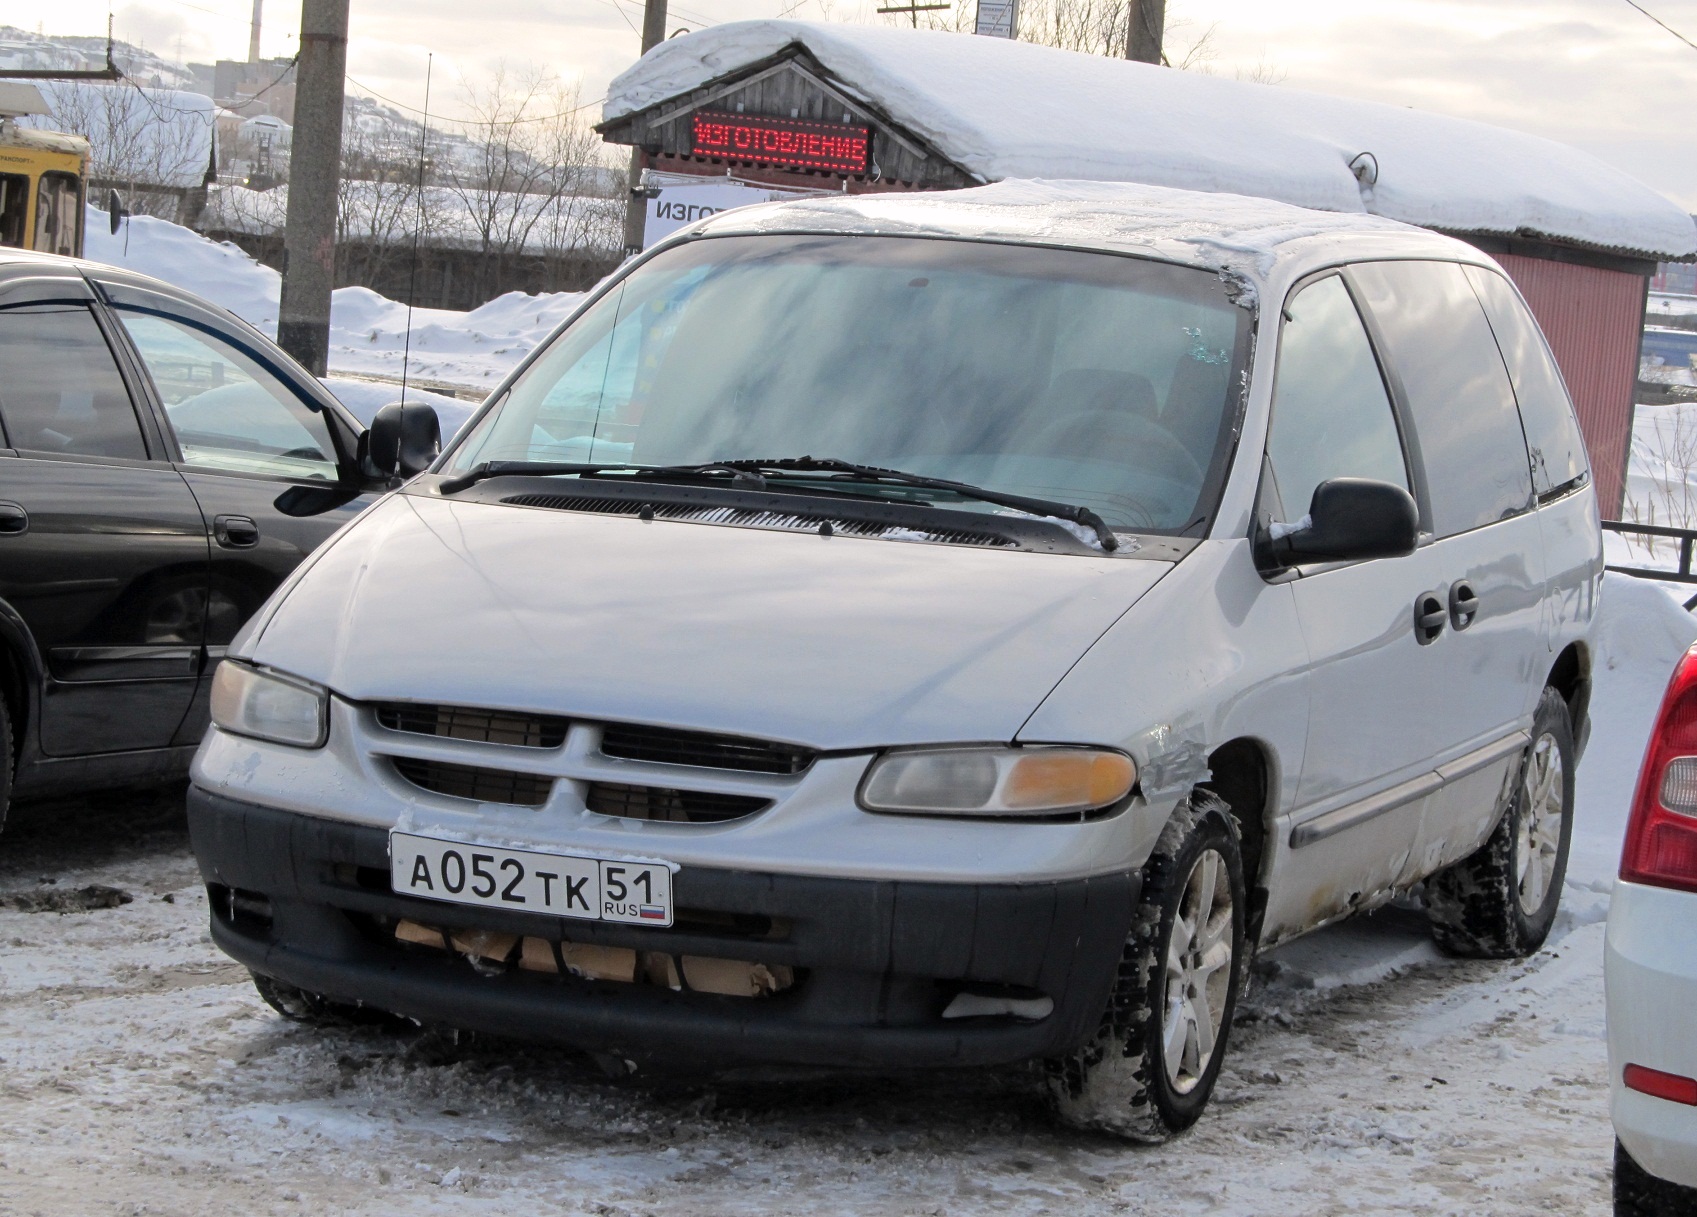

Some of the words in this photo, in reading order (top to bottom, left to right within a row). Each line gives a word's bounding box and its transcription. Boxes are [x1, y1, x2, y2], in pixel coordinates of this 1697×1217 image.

[697, 122, 867, 160] ИЗГОТОВЛЕНИЕ
[656, 201, 729, 221] ИЗГО
[606, 867, 652, 904] 51
[604, 901, 638, 917] RUS
